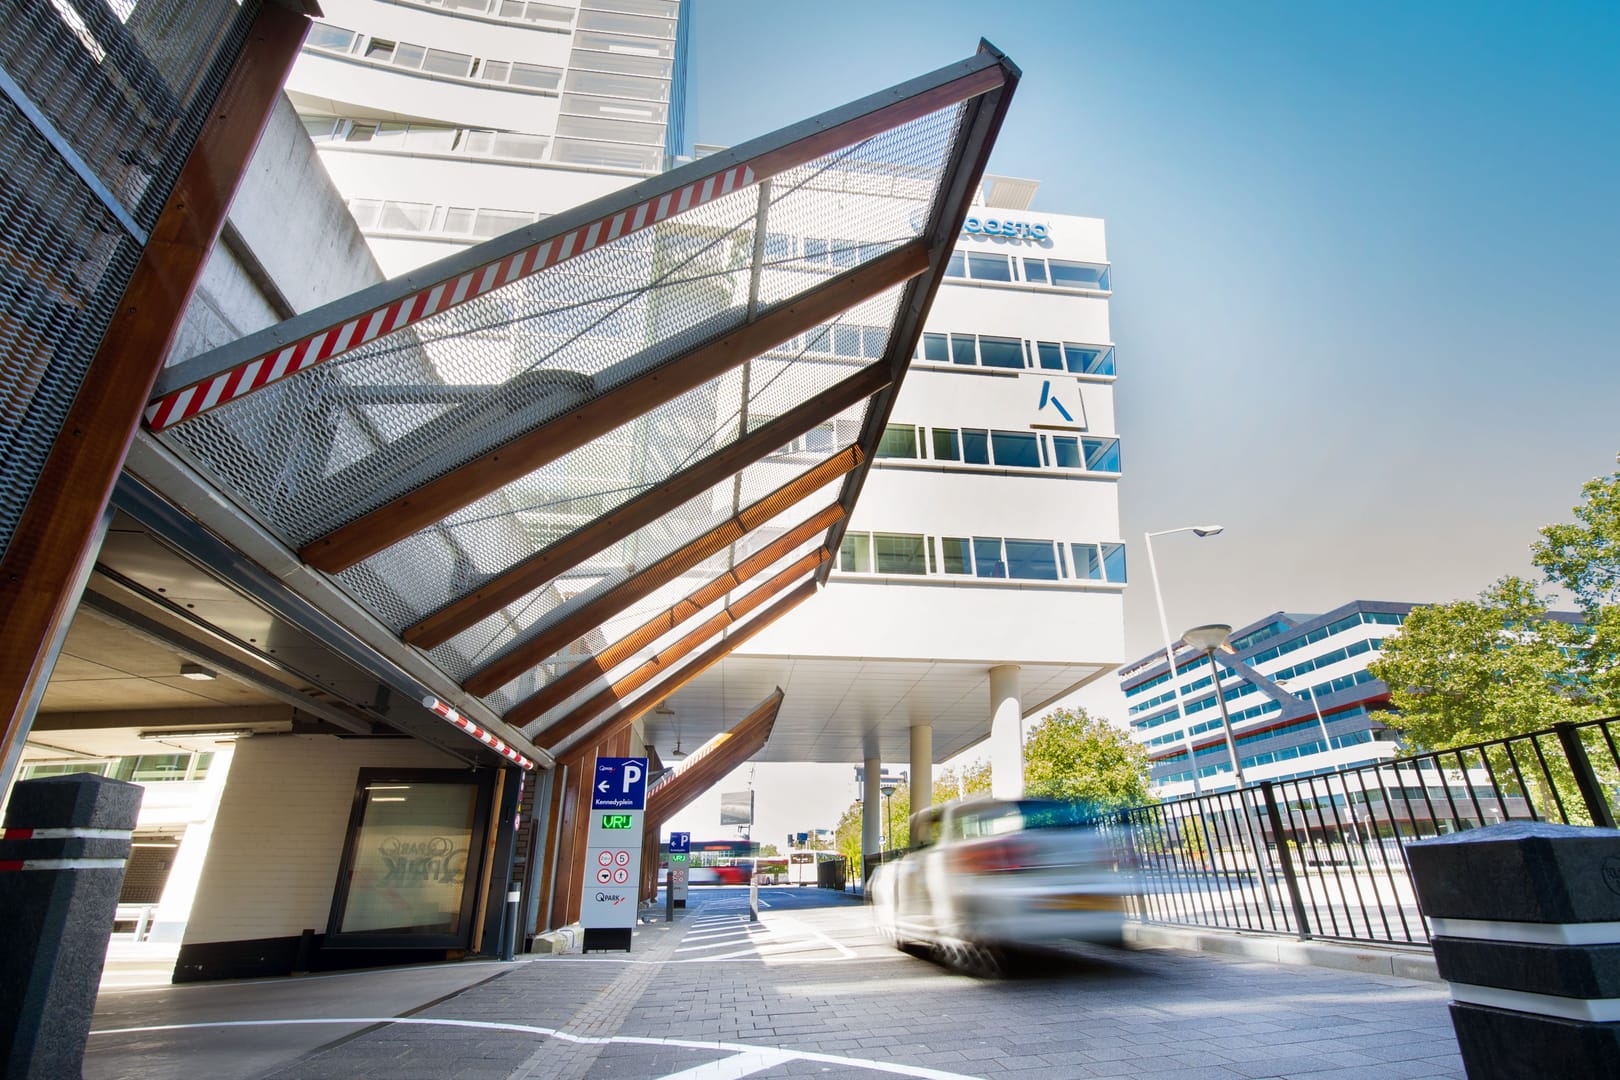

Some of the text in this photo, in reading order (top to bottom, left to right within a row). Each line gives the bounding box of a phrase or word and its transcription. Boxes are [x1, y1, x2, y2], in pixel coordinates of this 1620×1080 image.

[622, 765, 642, 793] P
[595, 798, 633, 807] Kennedyplein
[680, 835, 688, 847] P
[619, 854, 625, 863] 5
